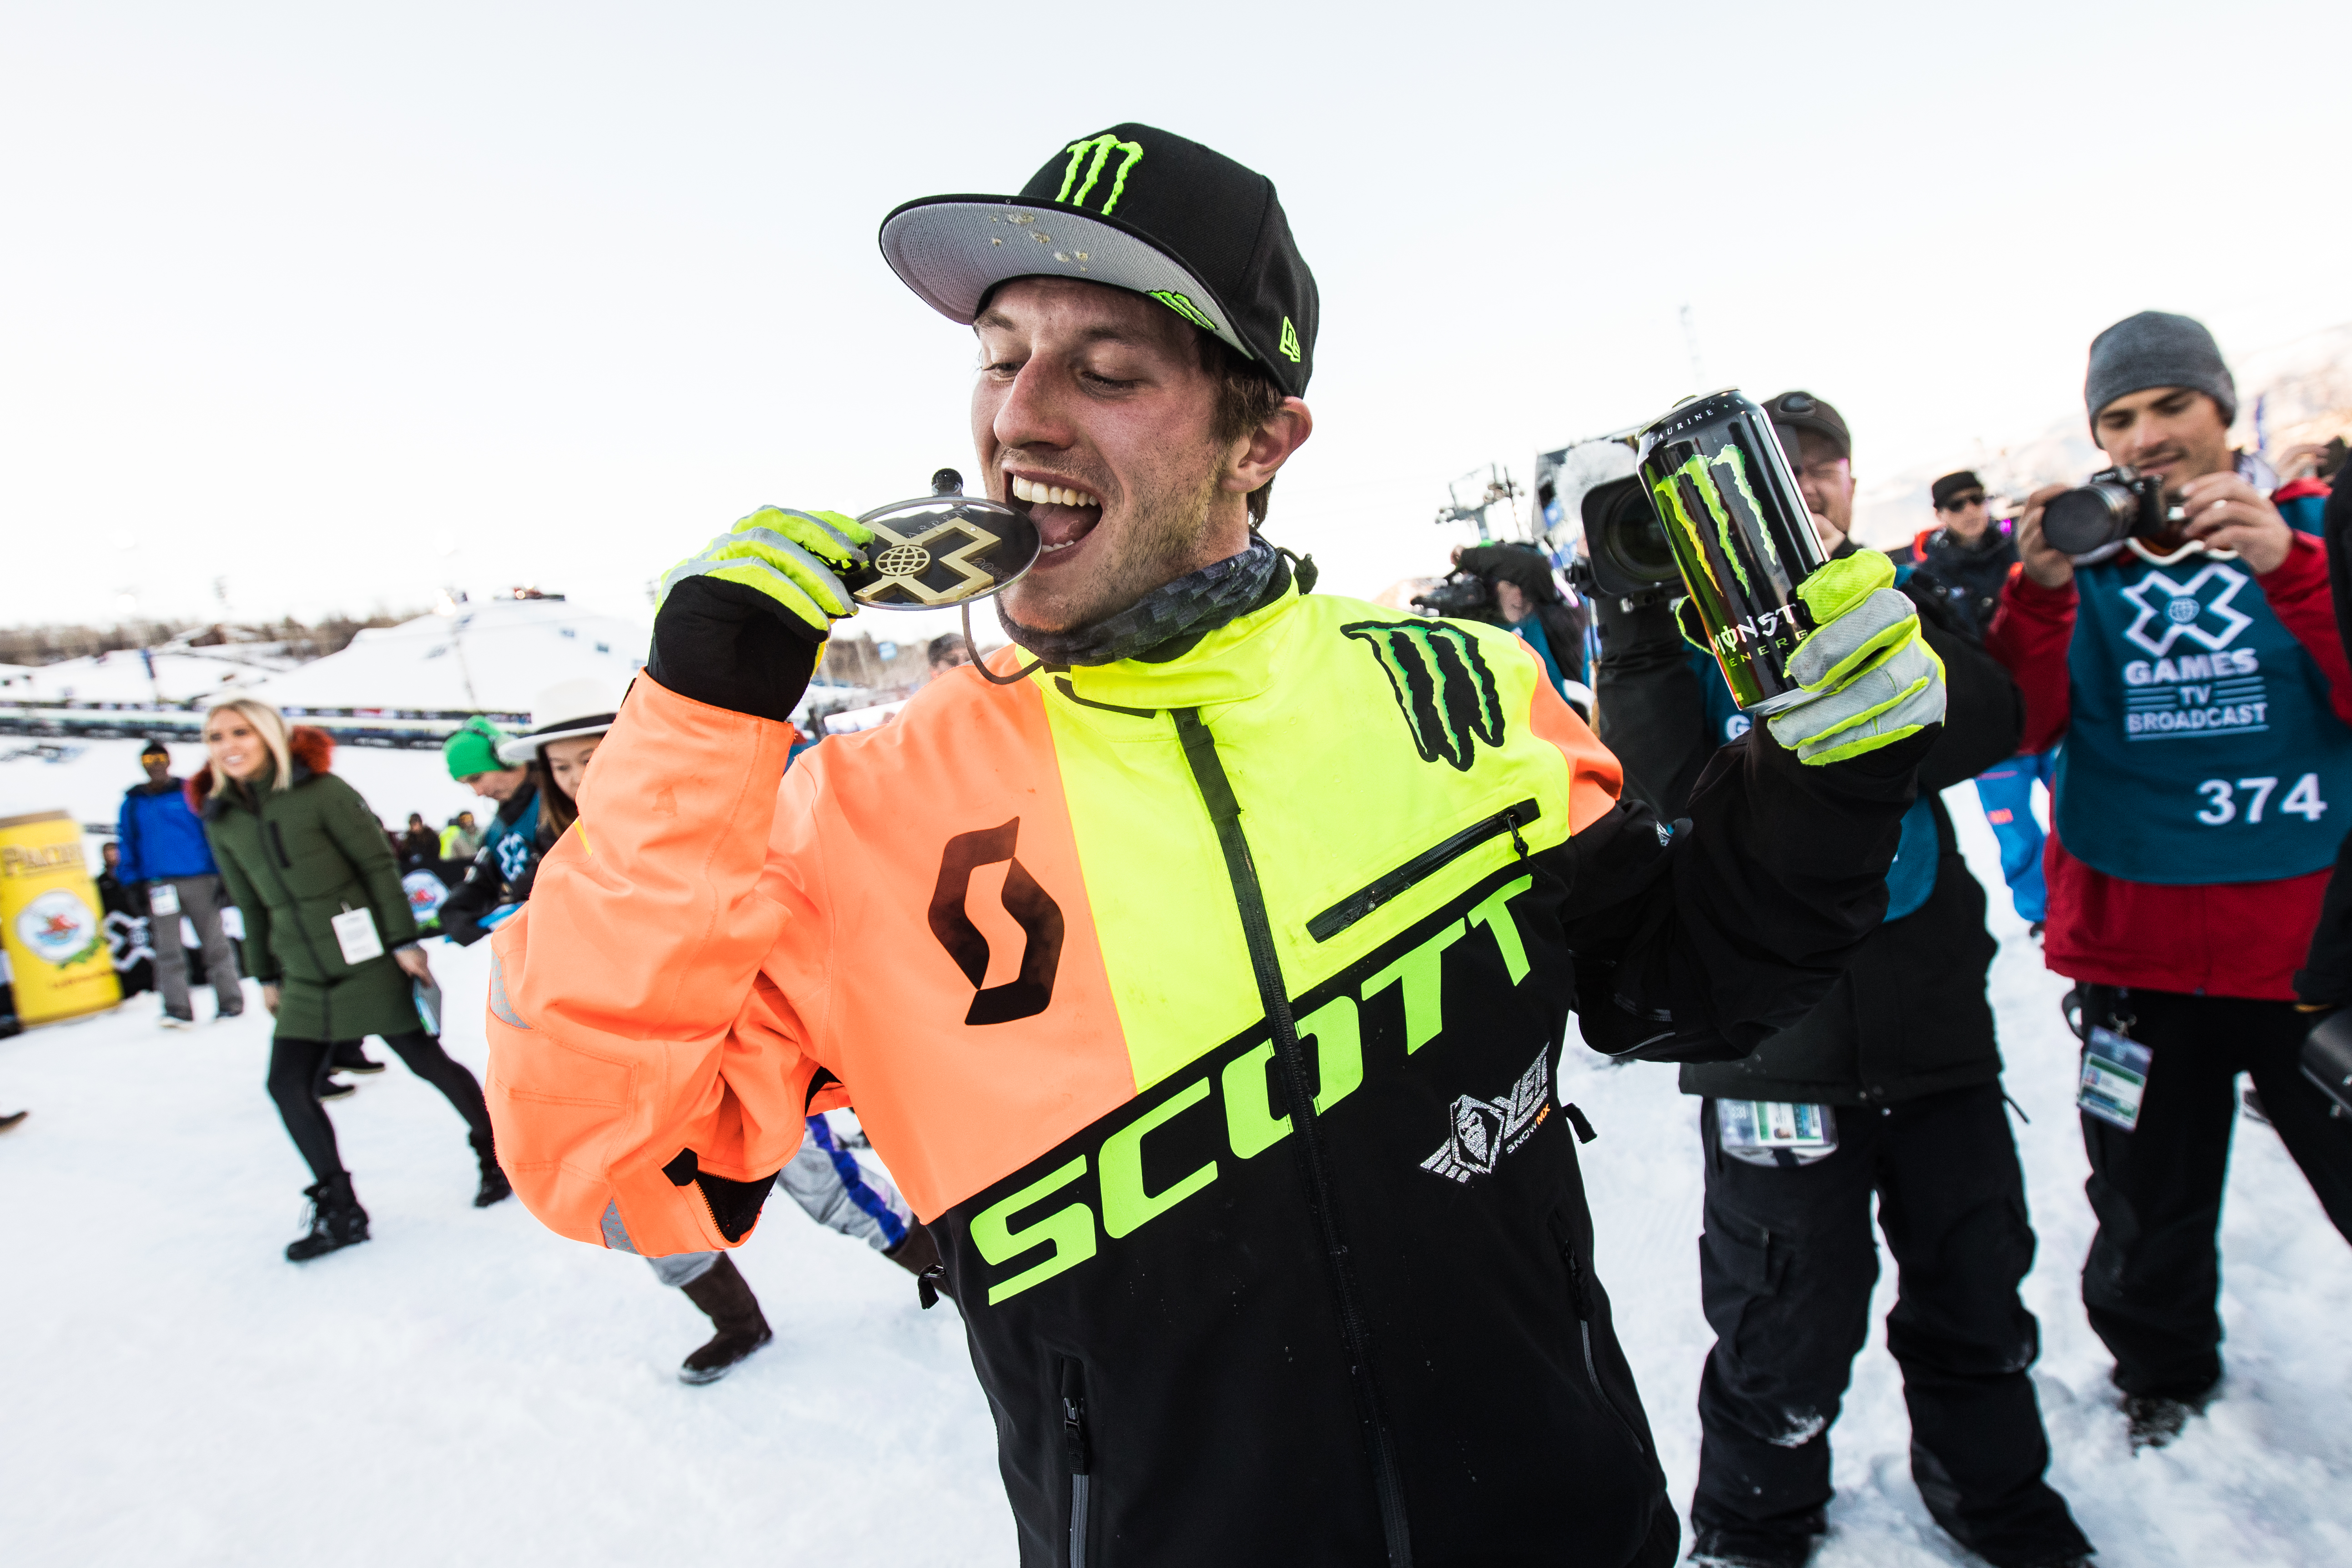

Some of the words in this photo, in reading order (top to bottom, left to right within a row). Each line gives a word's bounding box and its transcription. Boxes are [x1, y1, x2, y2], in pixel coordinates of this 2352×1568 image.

[1650, 409, 1714, 445] TAURINE
[1709, 603, 1806, 655] MONST
[2122, 647, 2259, 685] GAMES
[2178, 684, 2212, 705] TV
[2125, 702, 2268, 733] BROADCAST
[2195, 772, 2328, 826] 374
[970, 874, 1533, 1305] SCOTT
[1490, 1041, 1549, 1140] YETI
